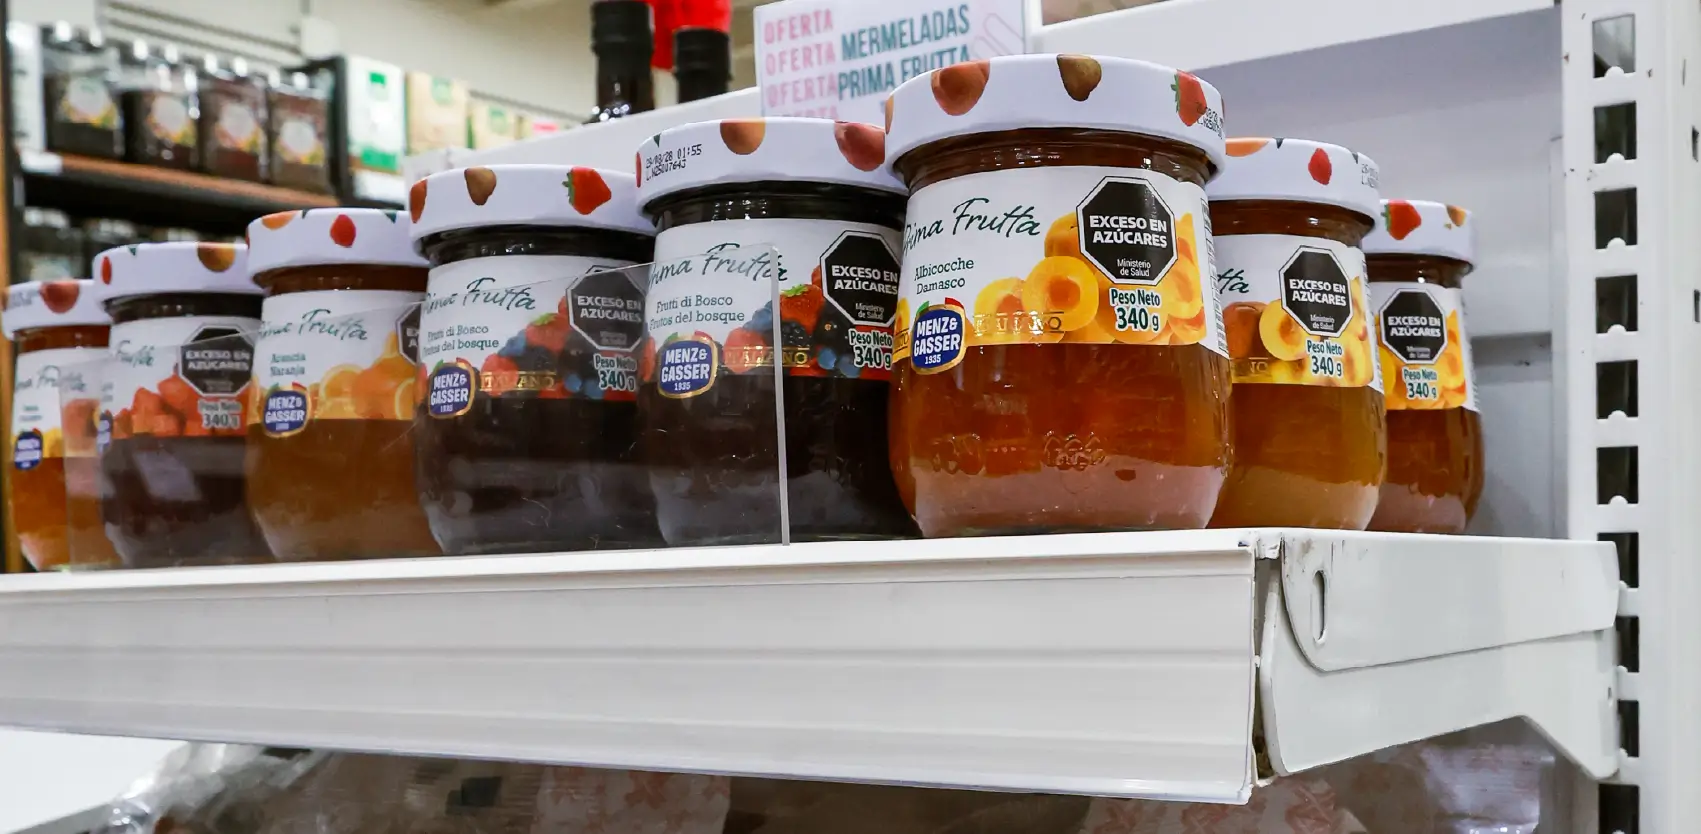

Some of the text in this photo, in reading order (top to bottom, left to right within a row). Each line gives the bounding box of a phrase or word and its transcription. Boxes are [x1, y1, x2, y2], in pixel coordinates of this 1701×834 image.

[764, 8, 833, 44] OFERTA
[841, 4, 970, 61] MERMELADAS
[765, 42, 836, 76] OFERTA
[838, 61, 895, 100] PRIMA
[766, 72, 840, 108] OFERTA
[677, 144, 702, 160] 01:55
[952, 198, 1041, 237] Frutta
[1089, 215, 1168, 233] EXCESO EN
[1092, 228, 1168, 248] AZÚCARES
[914, 257, 975, 281] Albicocche
[1117, 257, 1151, 269] Ministerio
[1120, 267, 1150, 277] de Salud
[831, 265, 898, 283] EXCESO EN
[464, 277, 536, 311] Frutta
[834, 277, 898, 295] AZÚCARES
[916, 277, 966, 295] Damasco
[1289, 278, 1346, 294] EXCESO EN
[577, 295, 642, 311] EXCESO EN
[680, 295, 692, 307] di
[694, 294, 733, 307] Bosco
[1111, 288, 1161, 307] Peso Neto
[1292, 289, 1347, 307] AZÚCARES
[580, 306, 642, 322] AZÚCARES
[675, 310, 693, 325] del
[696, 310, 745, 325] bosque
[1117, 307, 1160, 331] 340 g
[1387, 316, 1428, 326] EXCESO
[456, 324, 489, 337] Bosco
[916, 317, 958, 338] MENZ&
[1390, 326, 1442, 338] AZÚCARES
[457, 338, 500, 351] bosque
[849, 330, 871, 345] Peso
[872, 333, 892, 347] Neto
[913, 334, 961, 357] GASSER
[1306, 340, 1343, 355] Peso Neto
[594, 354, 616, 369] Peso
[665, 347, 707, 365] MENZ&
[854, 345, 892, 369] 340 g
[924, 353, 942, 365] 1935
[661, 363, 711, 383] GASSER
[1311, 355, 1342, 377] 340 g
[600, 370, 626, 391] 340
[431, 388, 469, 406] GASSER
[1408, 382, 1429, 398] 340
